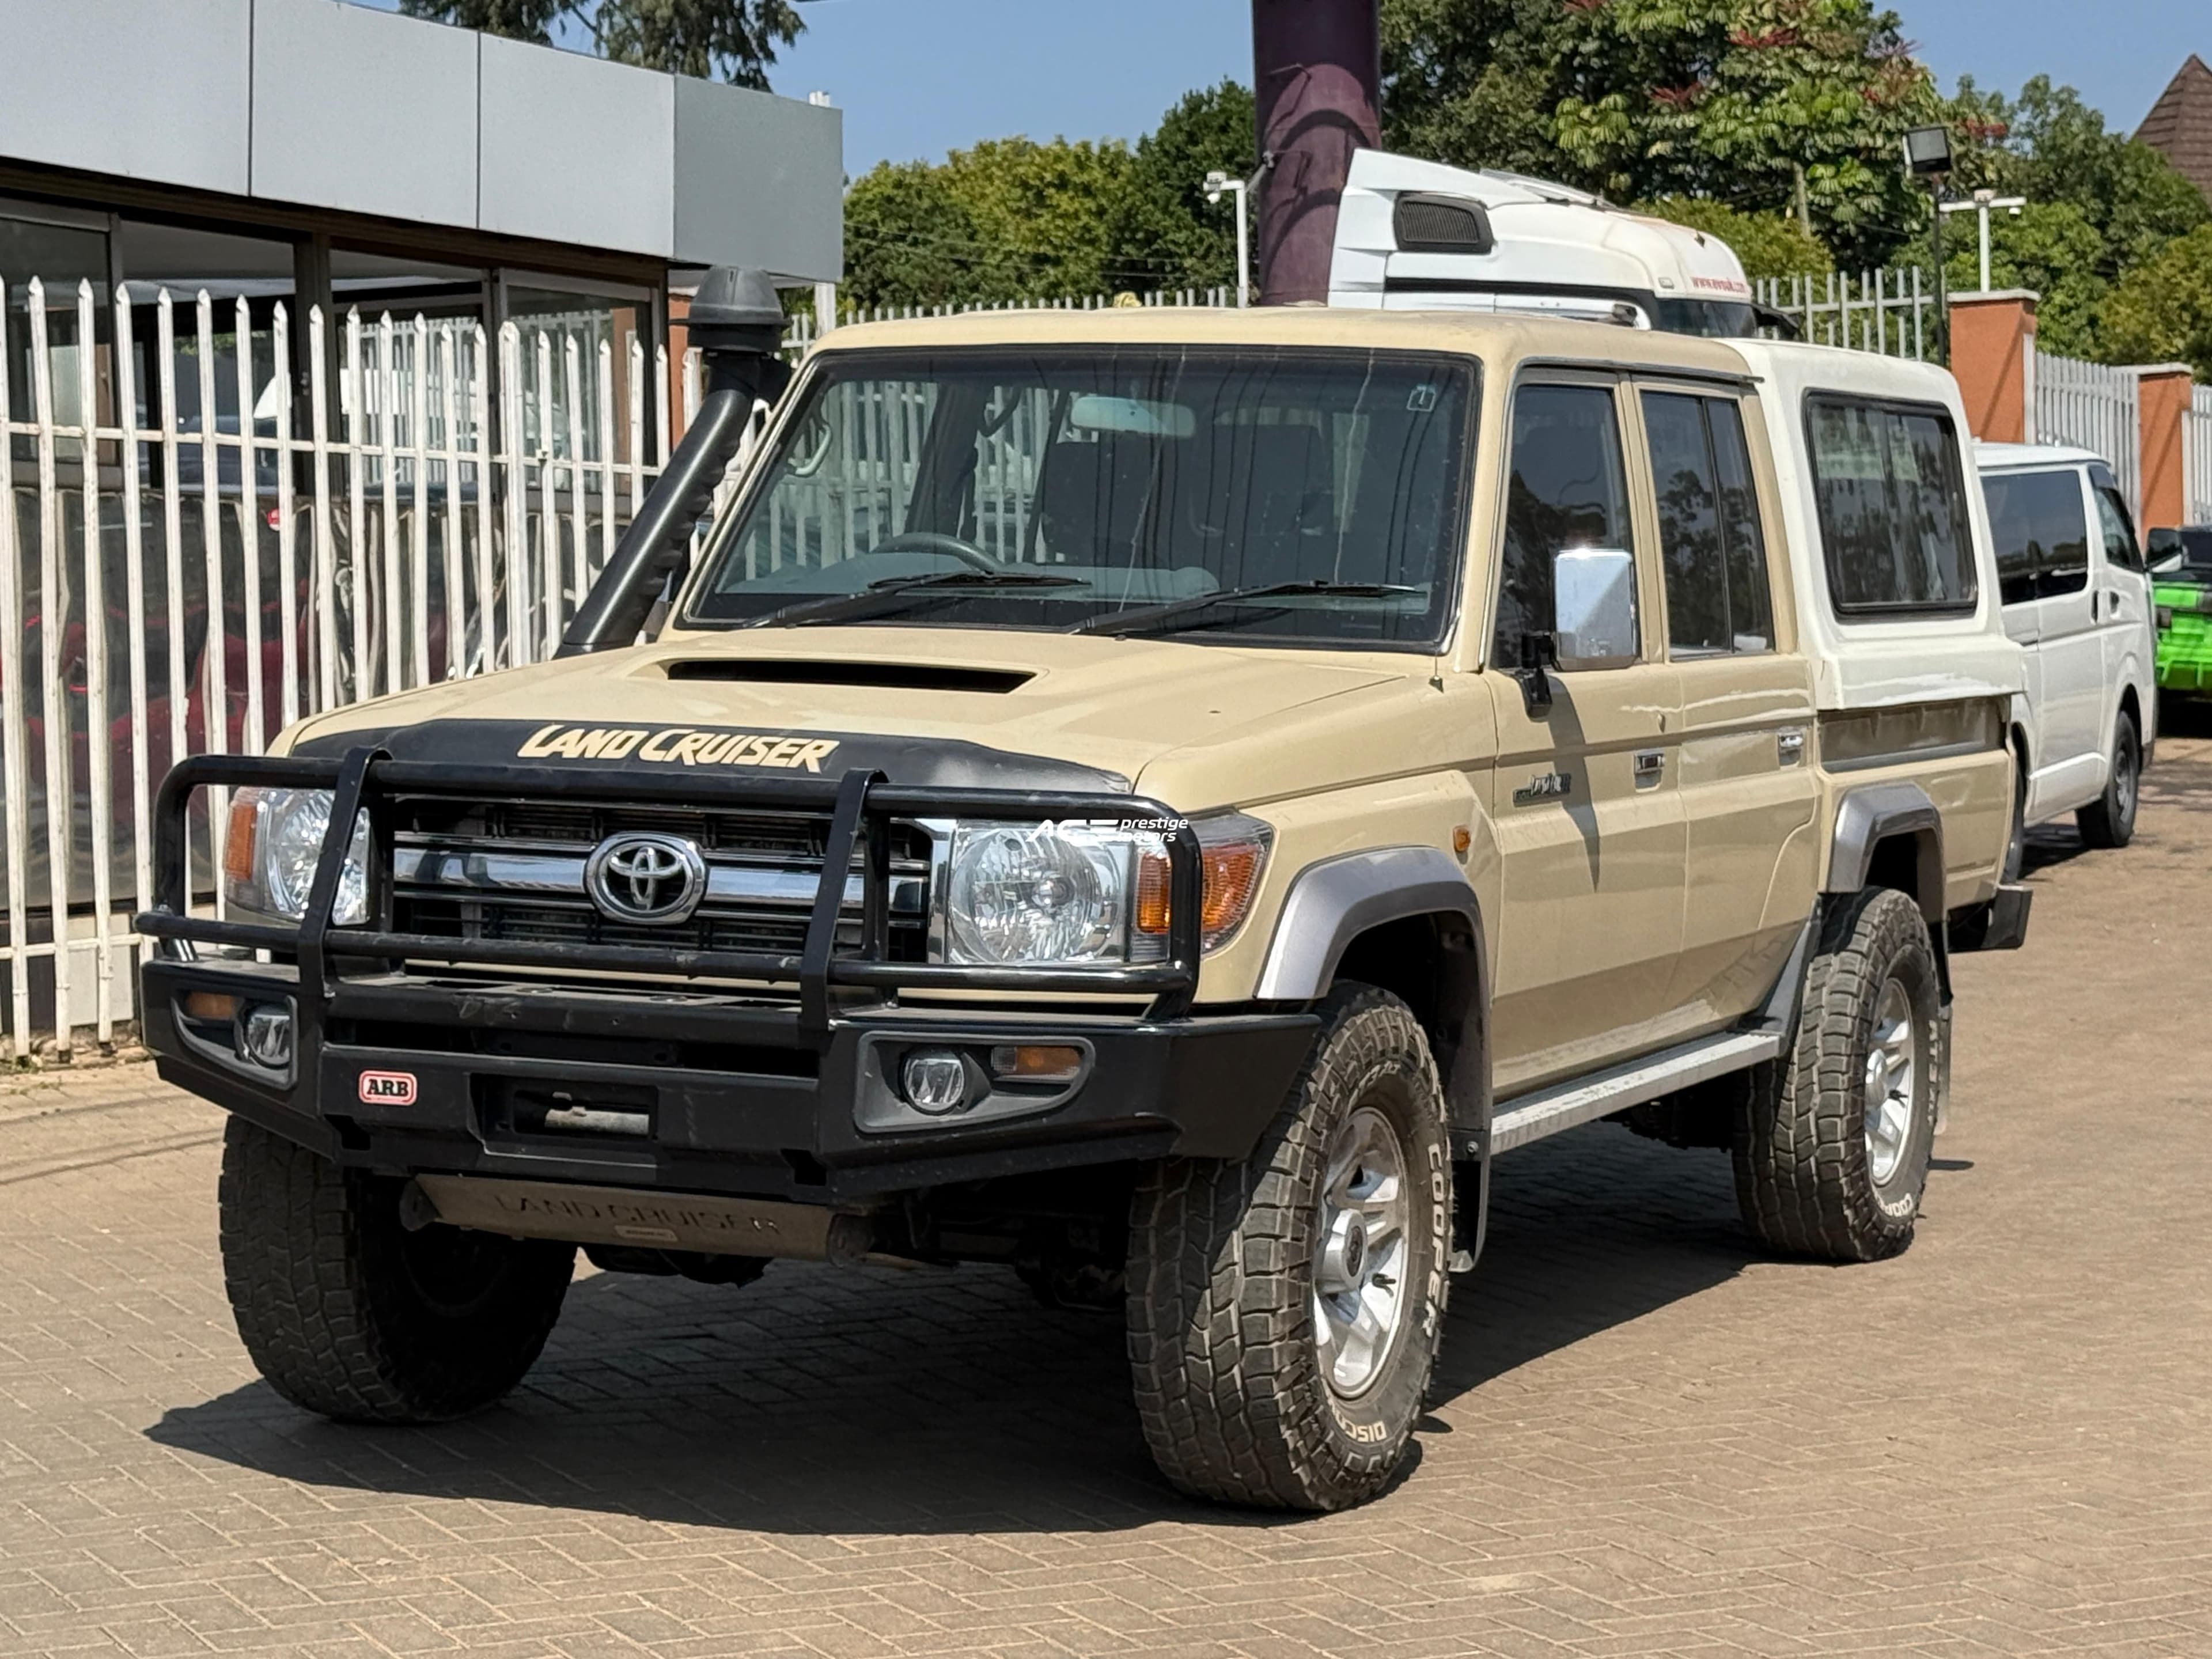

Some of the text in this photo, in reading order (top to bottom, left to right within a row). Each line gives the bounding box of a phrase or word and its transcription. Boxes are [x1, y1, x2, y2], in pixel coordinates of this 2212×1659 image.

[517, 724, 840, 774] LAND CRUISER
[367, 1078, 409, 1097] ARB
[1421, 1143, 1445, 1338] COOPER
